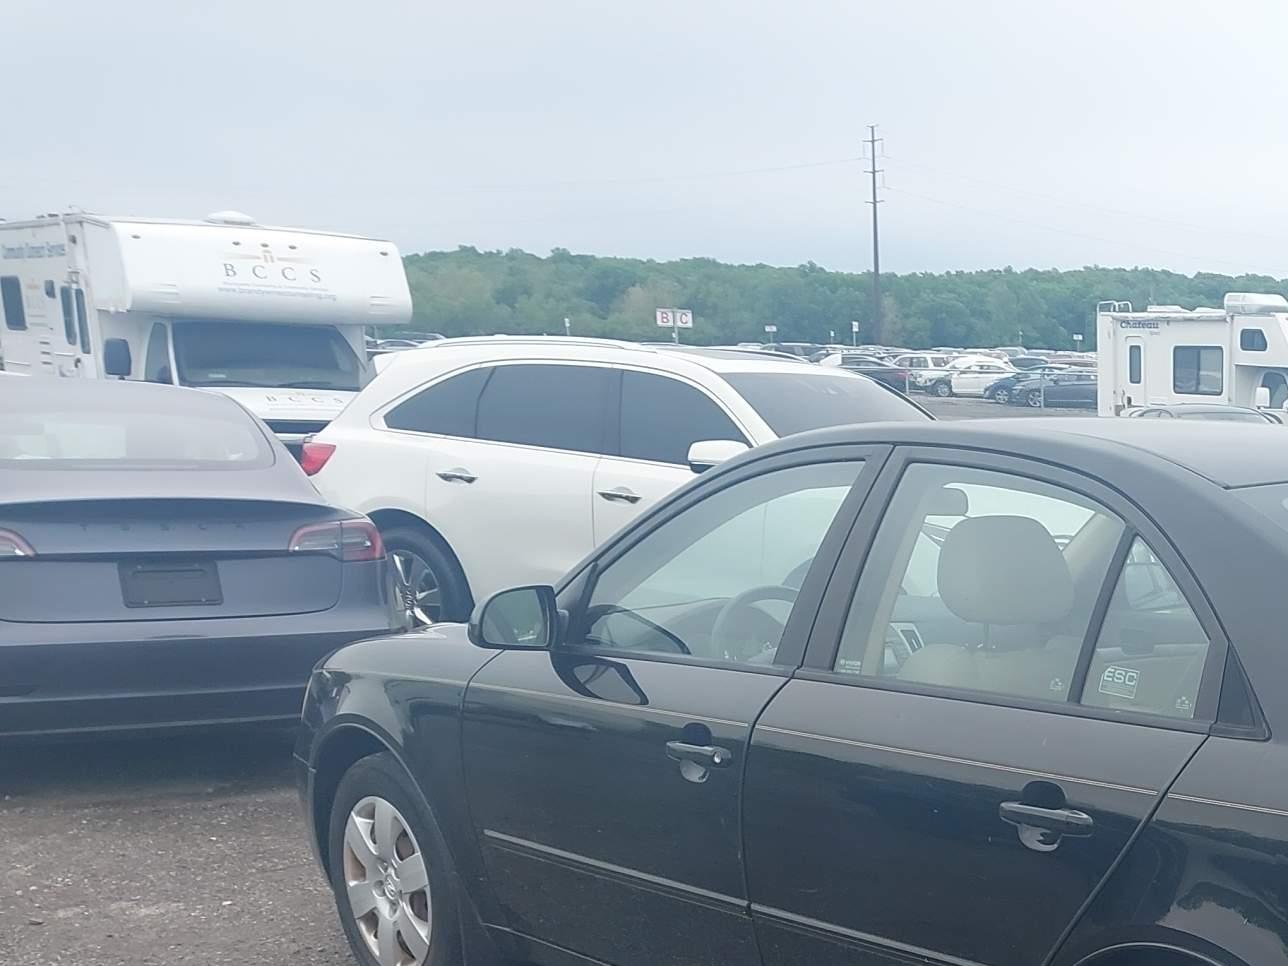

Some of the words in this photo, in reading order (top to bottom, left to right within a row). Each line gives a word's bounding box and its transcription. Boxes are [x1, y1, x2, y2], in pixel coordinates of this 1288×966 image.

[661, 312, 670, 324] B
[680, 312, 689, 325] C
[1120, 320, 1160, 329] Chateau
[1104, 667, 1137, 686] ESC
